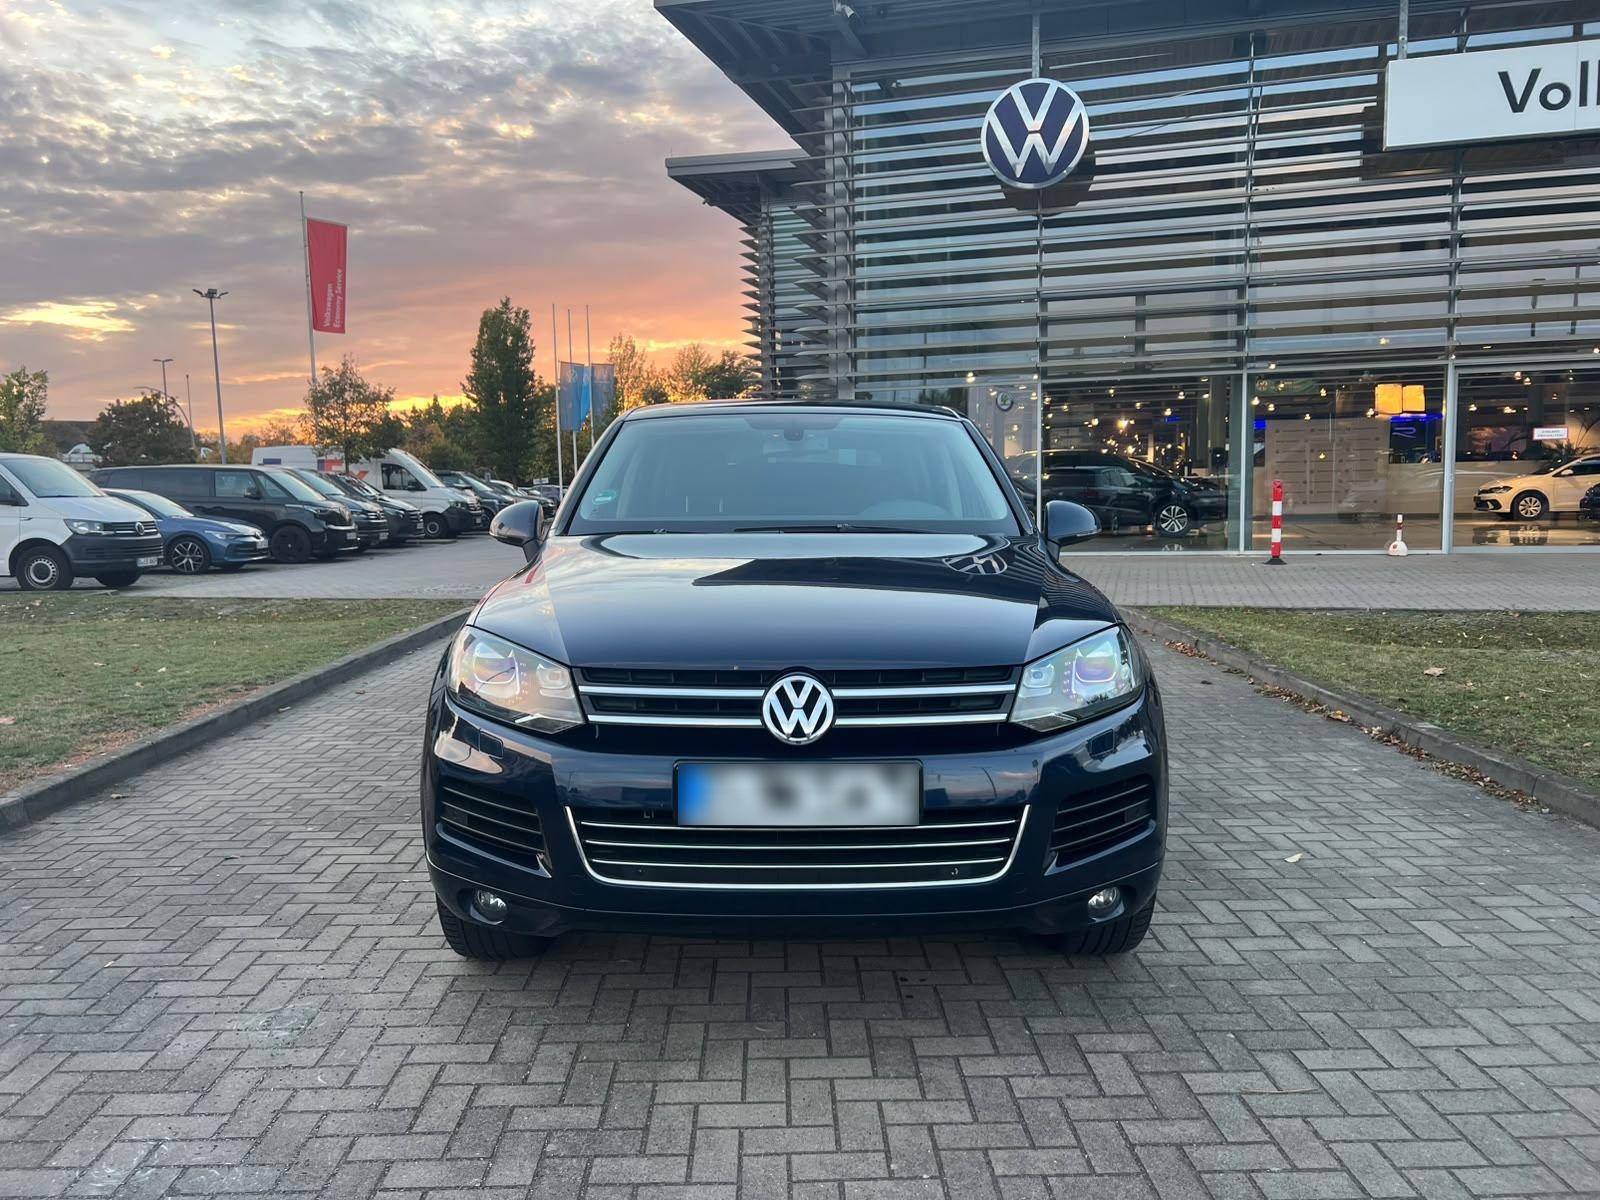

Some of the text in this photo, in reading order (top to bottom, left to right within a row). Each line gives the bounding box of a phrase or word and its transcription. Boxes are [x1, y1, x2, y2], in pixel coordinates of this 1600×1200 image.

[1498, 60, 1600, 114] Vol
[981, 78, 1090, 189] VW
[323, 283, 334, 327] Volkswagen
[334, 269, 343, 294] Service
[764, 674, 834, 744] VW
